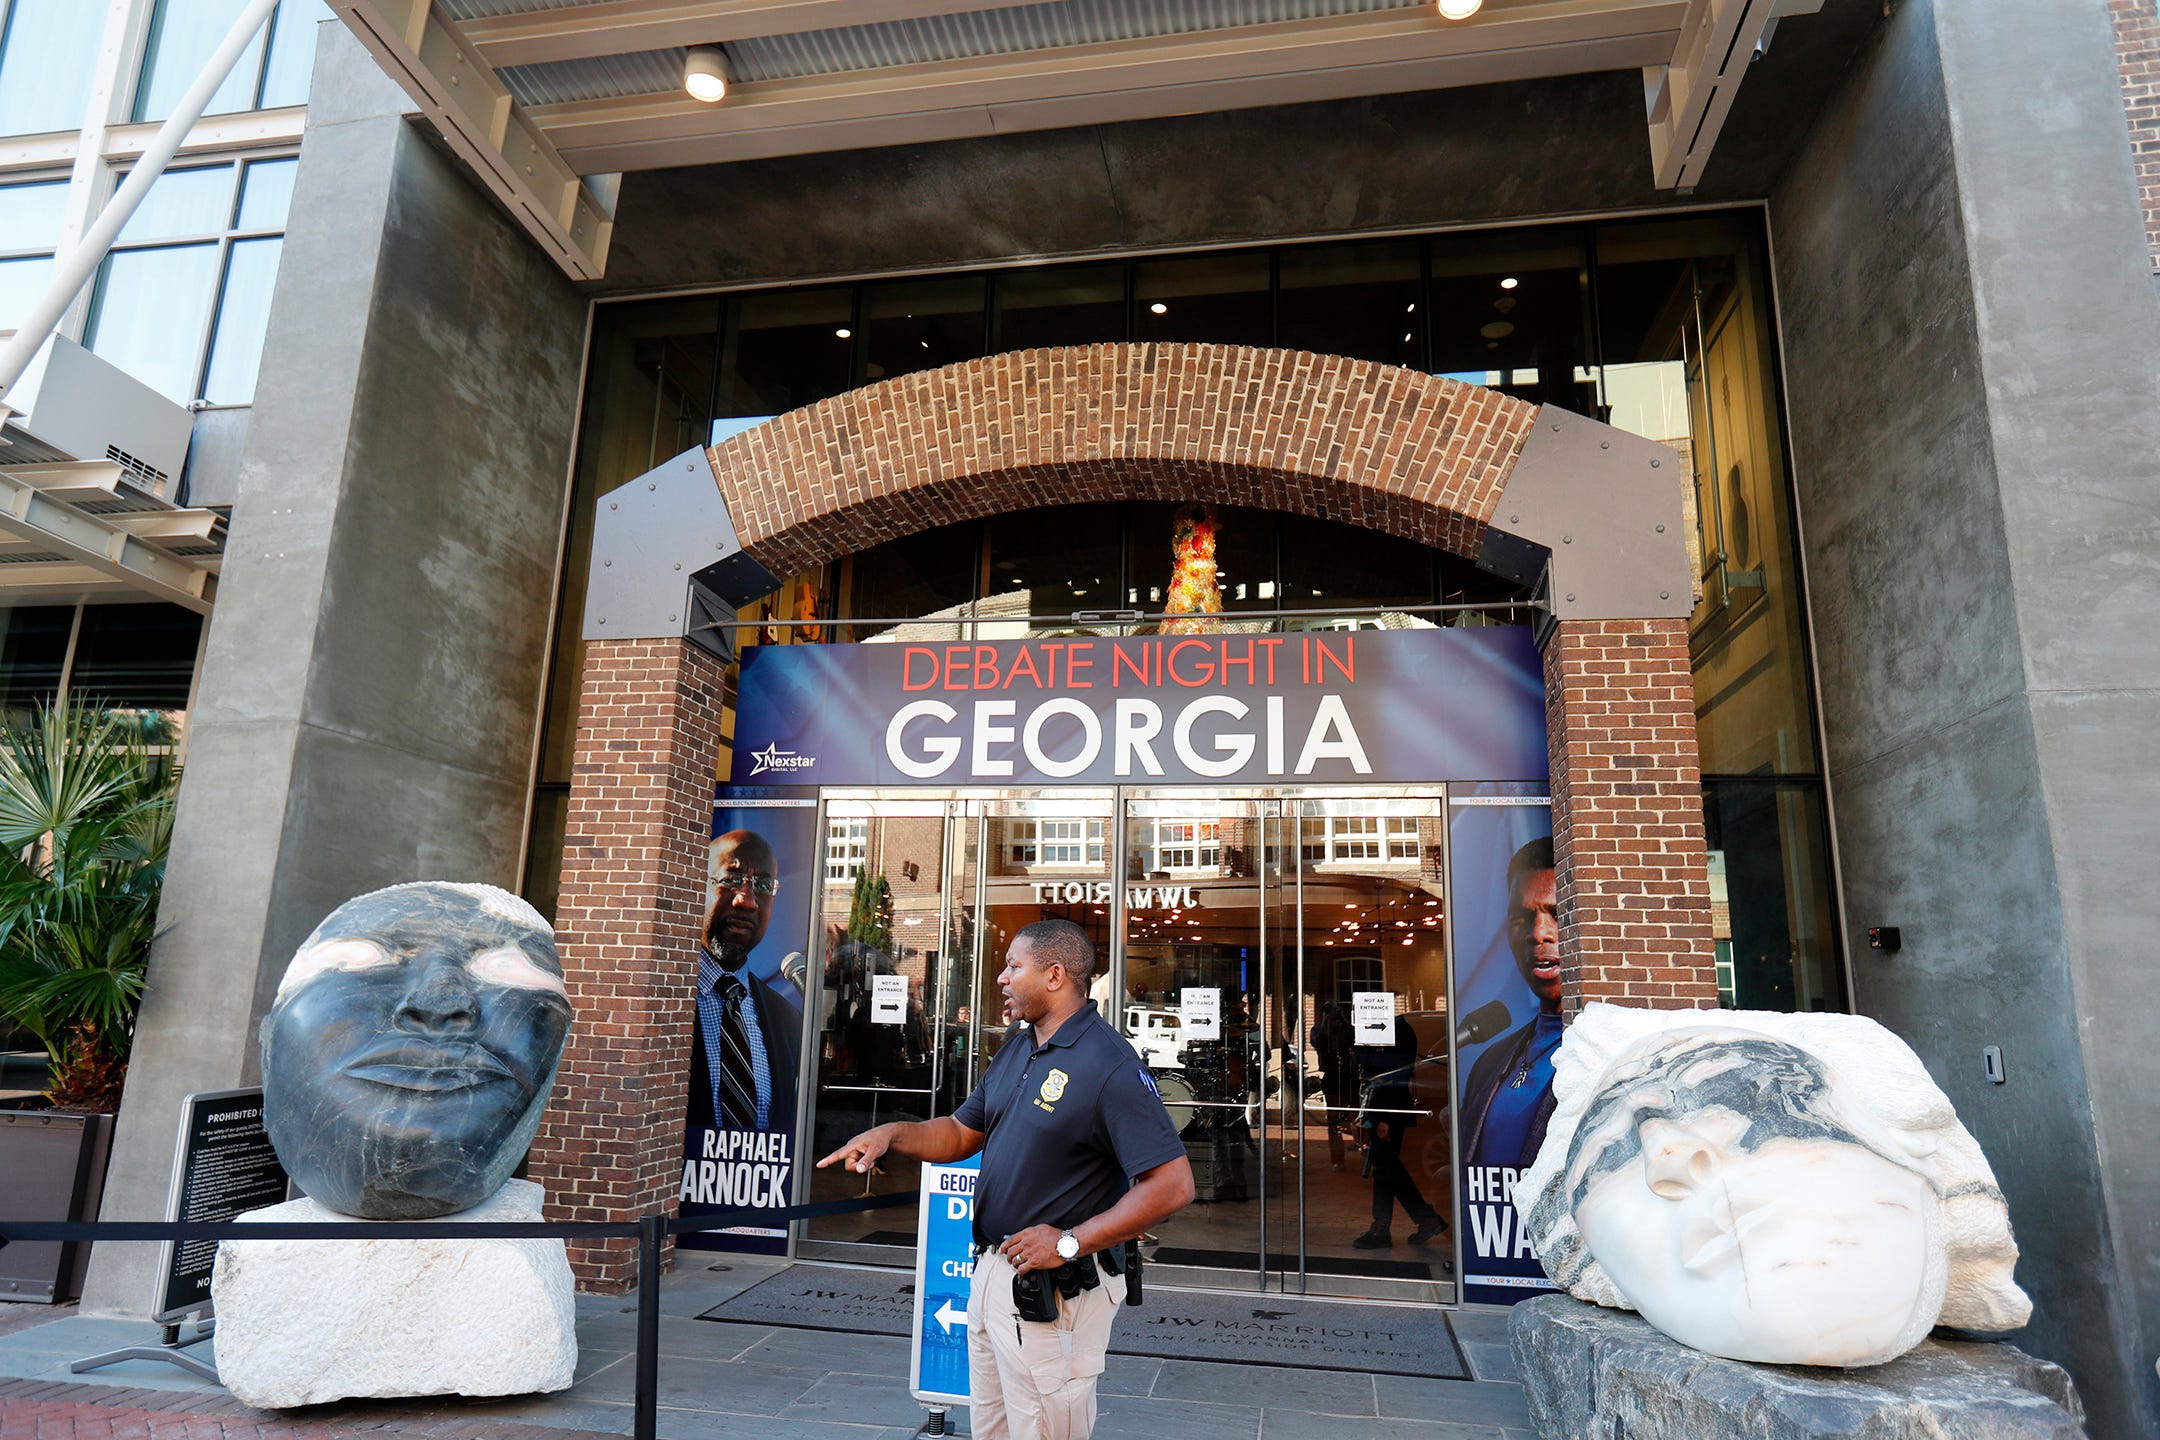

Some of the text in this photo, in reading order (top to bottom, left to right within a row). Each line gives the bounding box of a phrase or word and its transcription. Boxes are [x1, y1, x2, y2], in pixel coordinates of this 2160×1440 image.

[903, 637, 1355, 691] DEBATE NIGHT IN
[886, 694, 1373, 778] GEORGIA
[764, 754, 816, 767] Nexstar
[207, 1108, 258, 1124] PROHIBITED
[702, 1129, 791, 1164] RAPHAEL
[679, 1159, 790, 1208] ARNOCK
[1467, 1166, 1531, 1203] HER
[726, 1227, 771, 1235] HEADQUARTERS
[1468, 1204, 1540, 1260] WA
[196, 1276, 211, 1289] NO
[1511, 1278, 1535, 1286] LOCAL
[790, 1289, 848, 1299] JW
[753, 1302, 912, 1319] PLANT RIVERSID
[1147, 1316, 1401, 1342] JW MARRIOTT
[1215, 1332, 1326, 1345] SAVANNAH
[1121, 1331, 1424, 1360] PLANT RIVERSIDE DISTRICT
